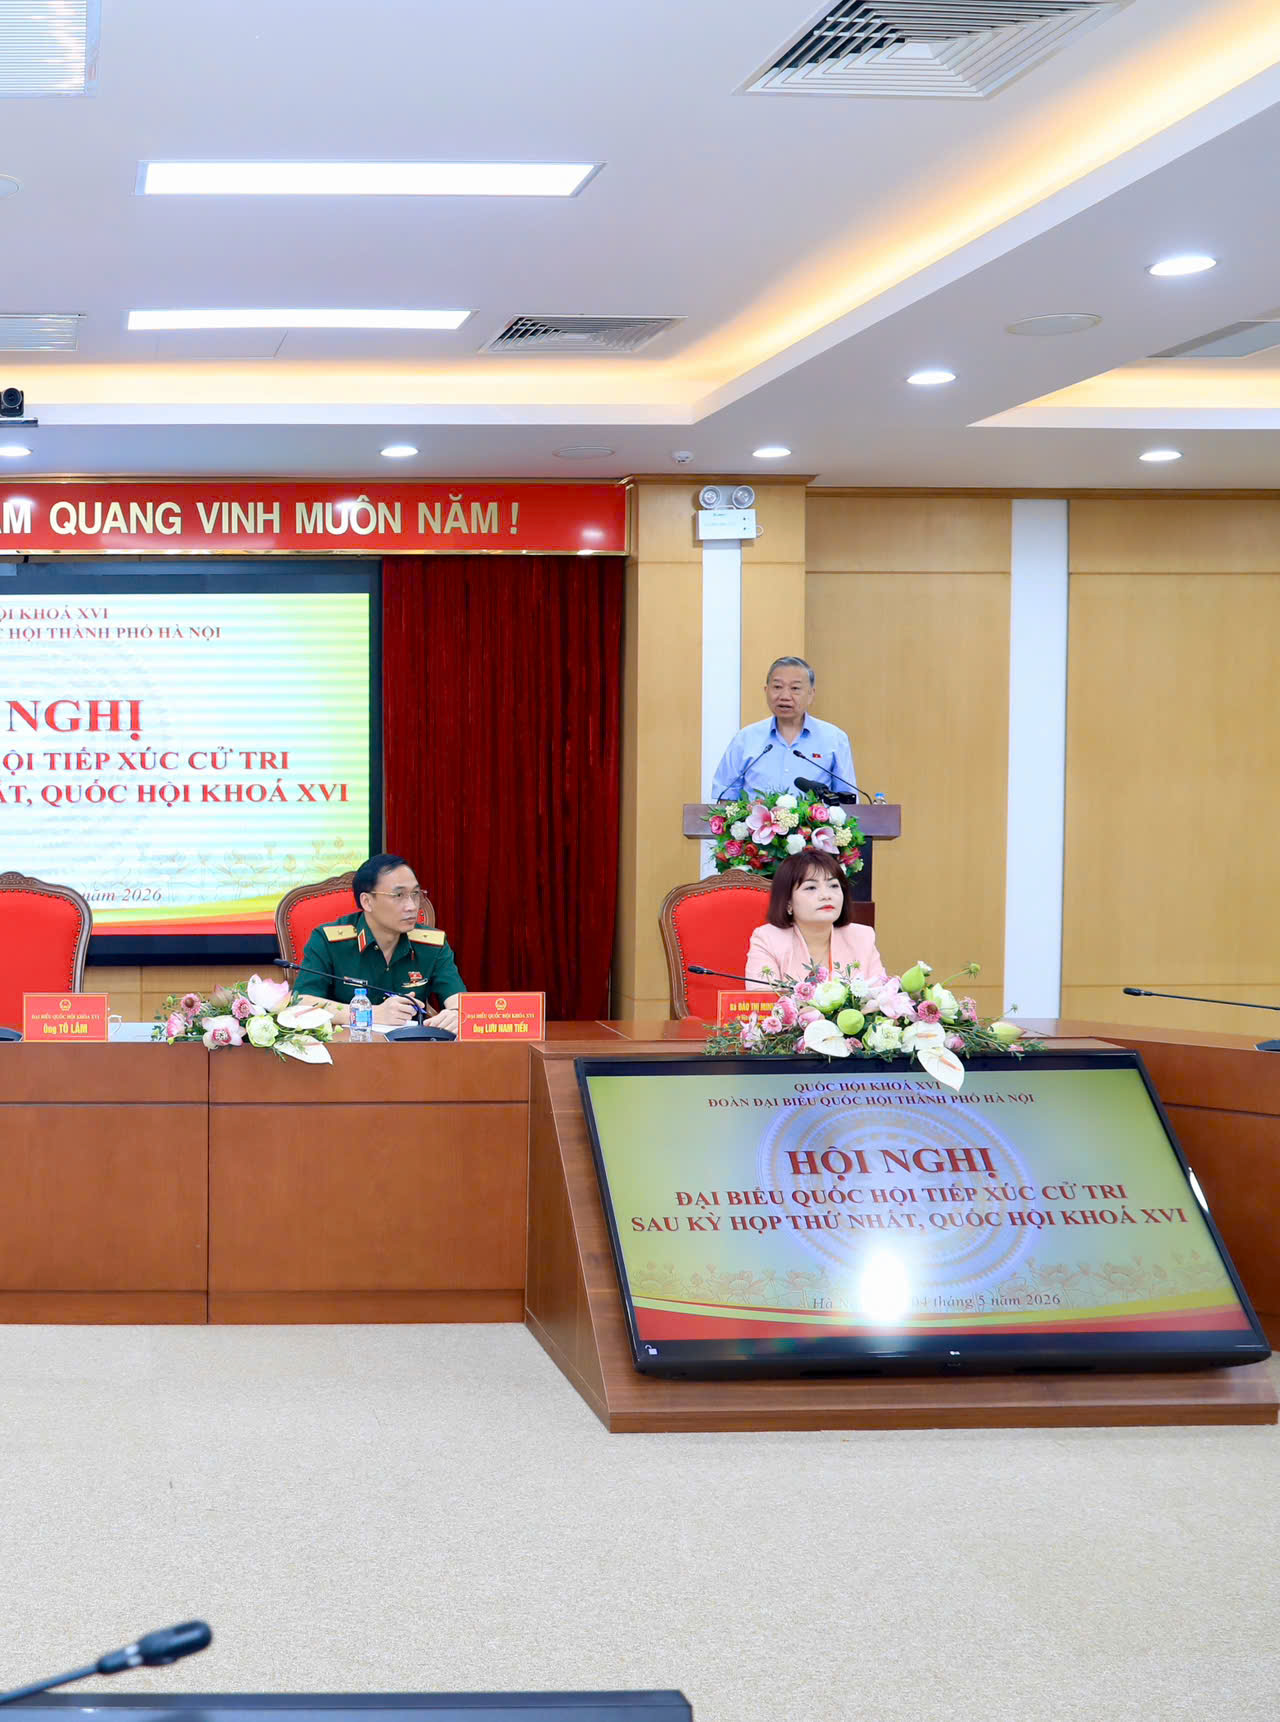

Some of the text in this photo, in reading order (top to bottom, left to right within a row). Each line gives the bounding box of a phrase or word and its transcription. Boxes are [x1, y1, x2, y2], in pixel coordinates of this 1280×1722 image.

[49, 501, 183, 536] QUANG
[196, 501, 280, 534] VINH
[295, 495, 401, 535] MUÔN
[418, 493, 499, 534] NĂM
[510, 501, 519, 534] !
[20, 604, 71, 621] KHOÁ
[77, 607, 109, 621] XVI
[8, 624, 41, 643] HỘI
[46, 624, 110, 640] THÀNH
[158, 624, 183, 639] HÀ
[188, 624, 221, 643] NỘI
[6, 698, 144, 742] NGHỊ
[43, 746, 111, 771] TIẾP
[118, 746, 179, 771] XÚC
[187, 746, 235, 771] CỬ
[239, 751, 291, 770] TRI
[41, 779, 128, 808] QUỐC
[136, 781, 191, 808] HỘI
[200, 778, 289, 803] KHOÁ
[297, 783, 349, 802] XVI
[121, 888, 162, 902] 2026
[870, 1079, 912, 1091] KHOÁ
[915, 1081, 942, 1090] XVI
[708, 1096, 749, 1108] ĐOÀN
[753, 1097, 778, 1109] ĐẠI
[895, 1093, 947, 1105] THÀNH
[984, 1093, 1005, 1103] HÀ
[1008, 1092, 1035, 1104] NỘI
[784, 1145, 998, 1181] HỘI NGHỊ
[674, 1181, 1129, 1210] ĐẠI BIỂU QUỐC HỘI TIẾP XÚC CỬ TRI
[631, 1205, 1189, 1234] SAU KỲ HỌP THỨ NHẤT, QUỐC HỘI KHOÁ XVI
[933, 1296, 973, 1309] tháng
[978, 1295, 985, 1305] 5
[991, 1295, 1021, 1305] năm
[1026, 1294, 1061, 1305] 2026
